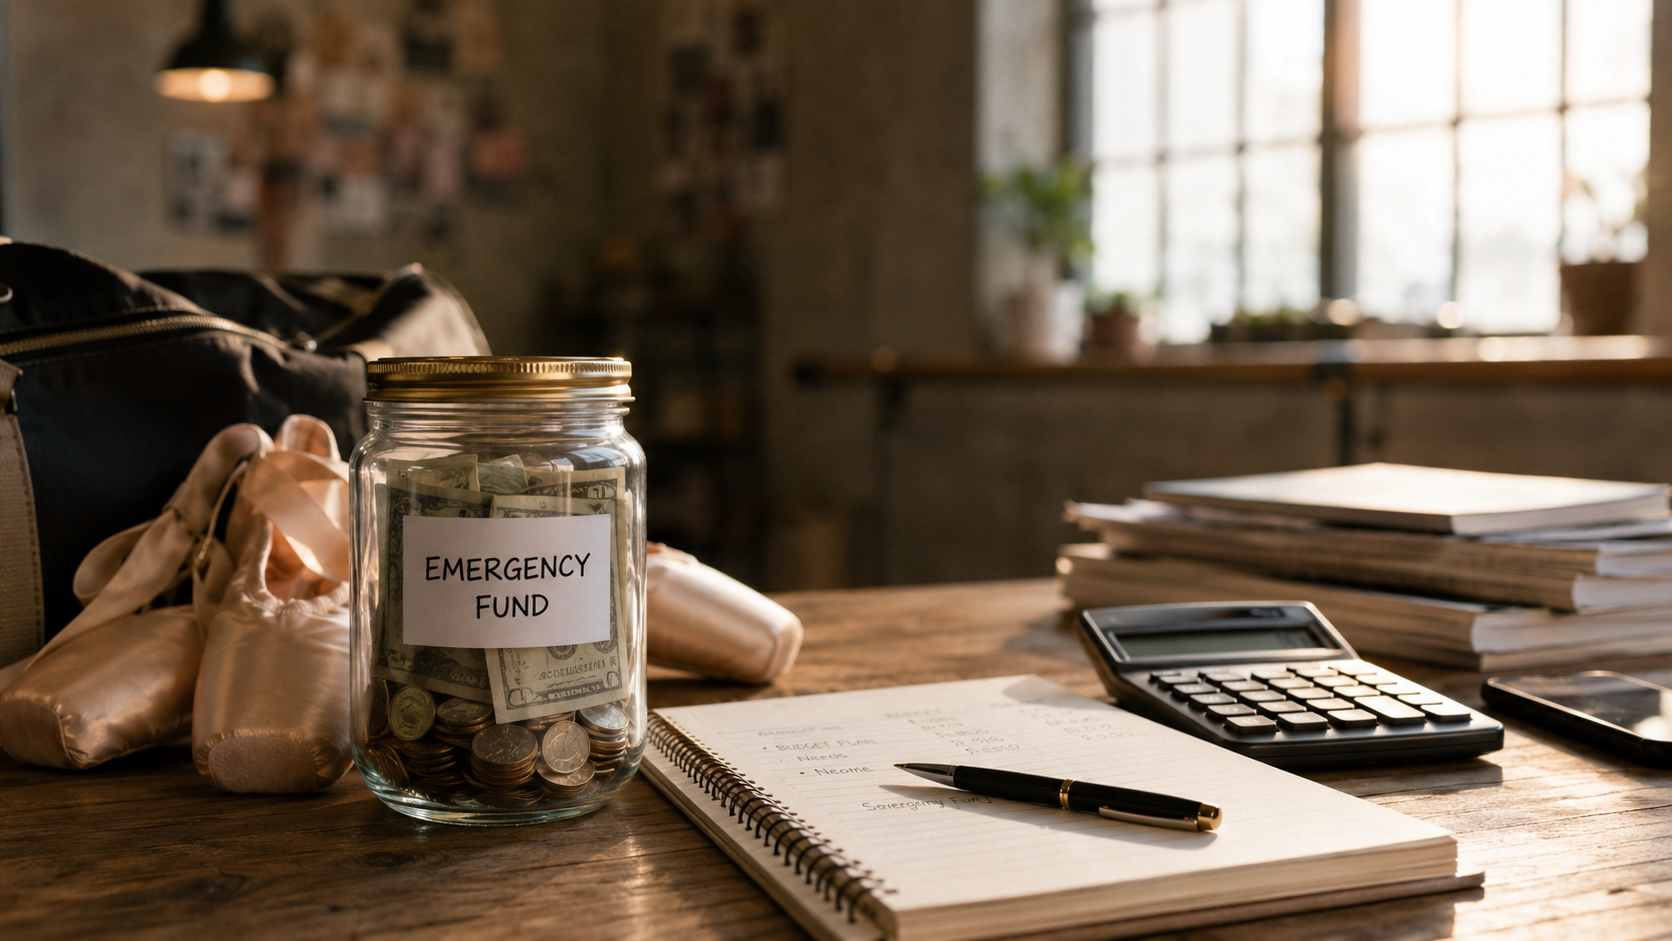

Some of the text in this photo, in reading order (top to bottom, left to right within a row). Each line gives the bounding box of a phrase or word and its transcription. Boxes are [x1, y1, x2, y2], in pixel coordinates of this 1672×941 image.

[425, 552, 591, 582] EMERGENCY
[475, 593, 549, 620] FUND
[775, 740, 831, 752] BUDGET
